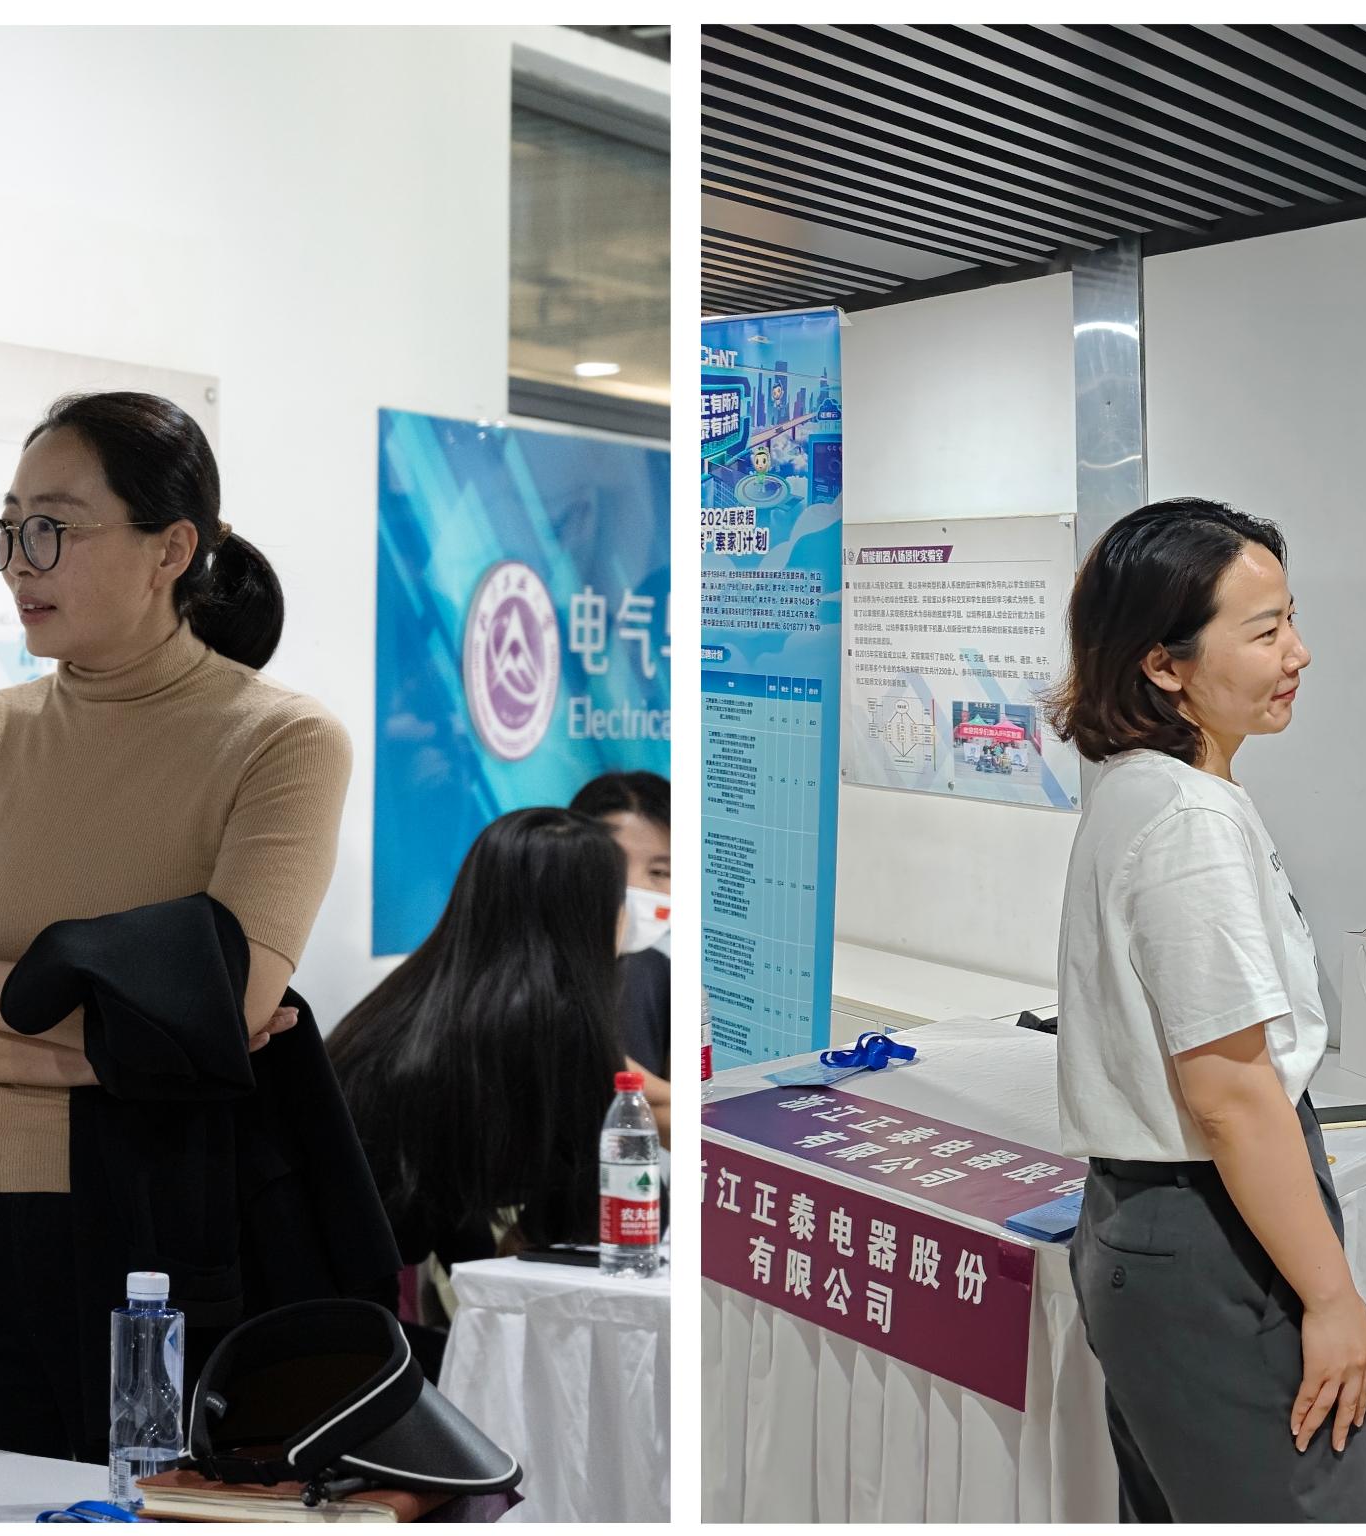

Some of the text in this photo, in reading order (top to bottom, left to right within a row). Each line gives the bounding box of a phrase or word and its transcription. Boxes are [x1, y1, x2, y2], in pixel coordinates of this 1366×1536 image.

[861, 549, 944, 564] 智能机器人场景化实验室
[793, 1130, 968, 1189] 有限公司
[749, 1234, 893, 1334] 有限公司
